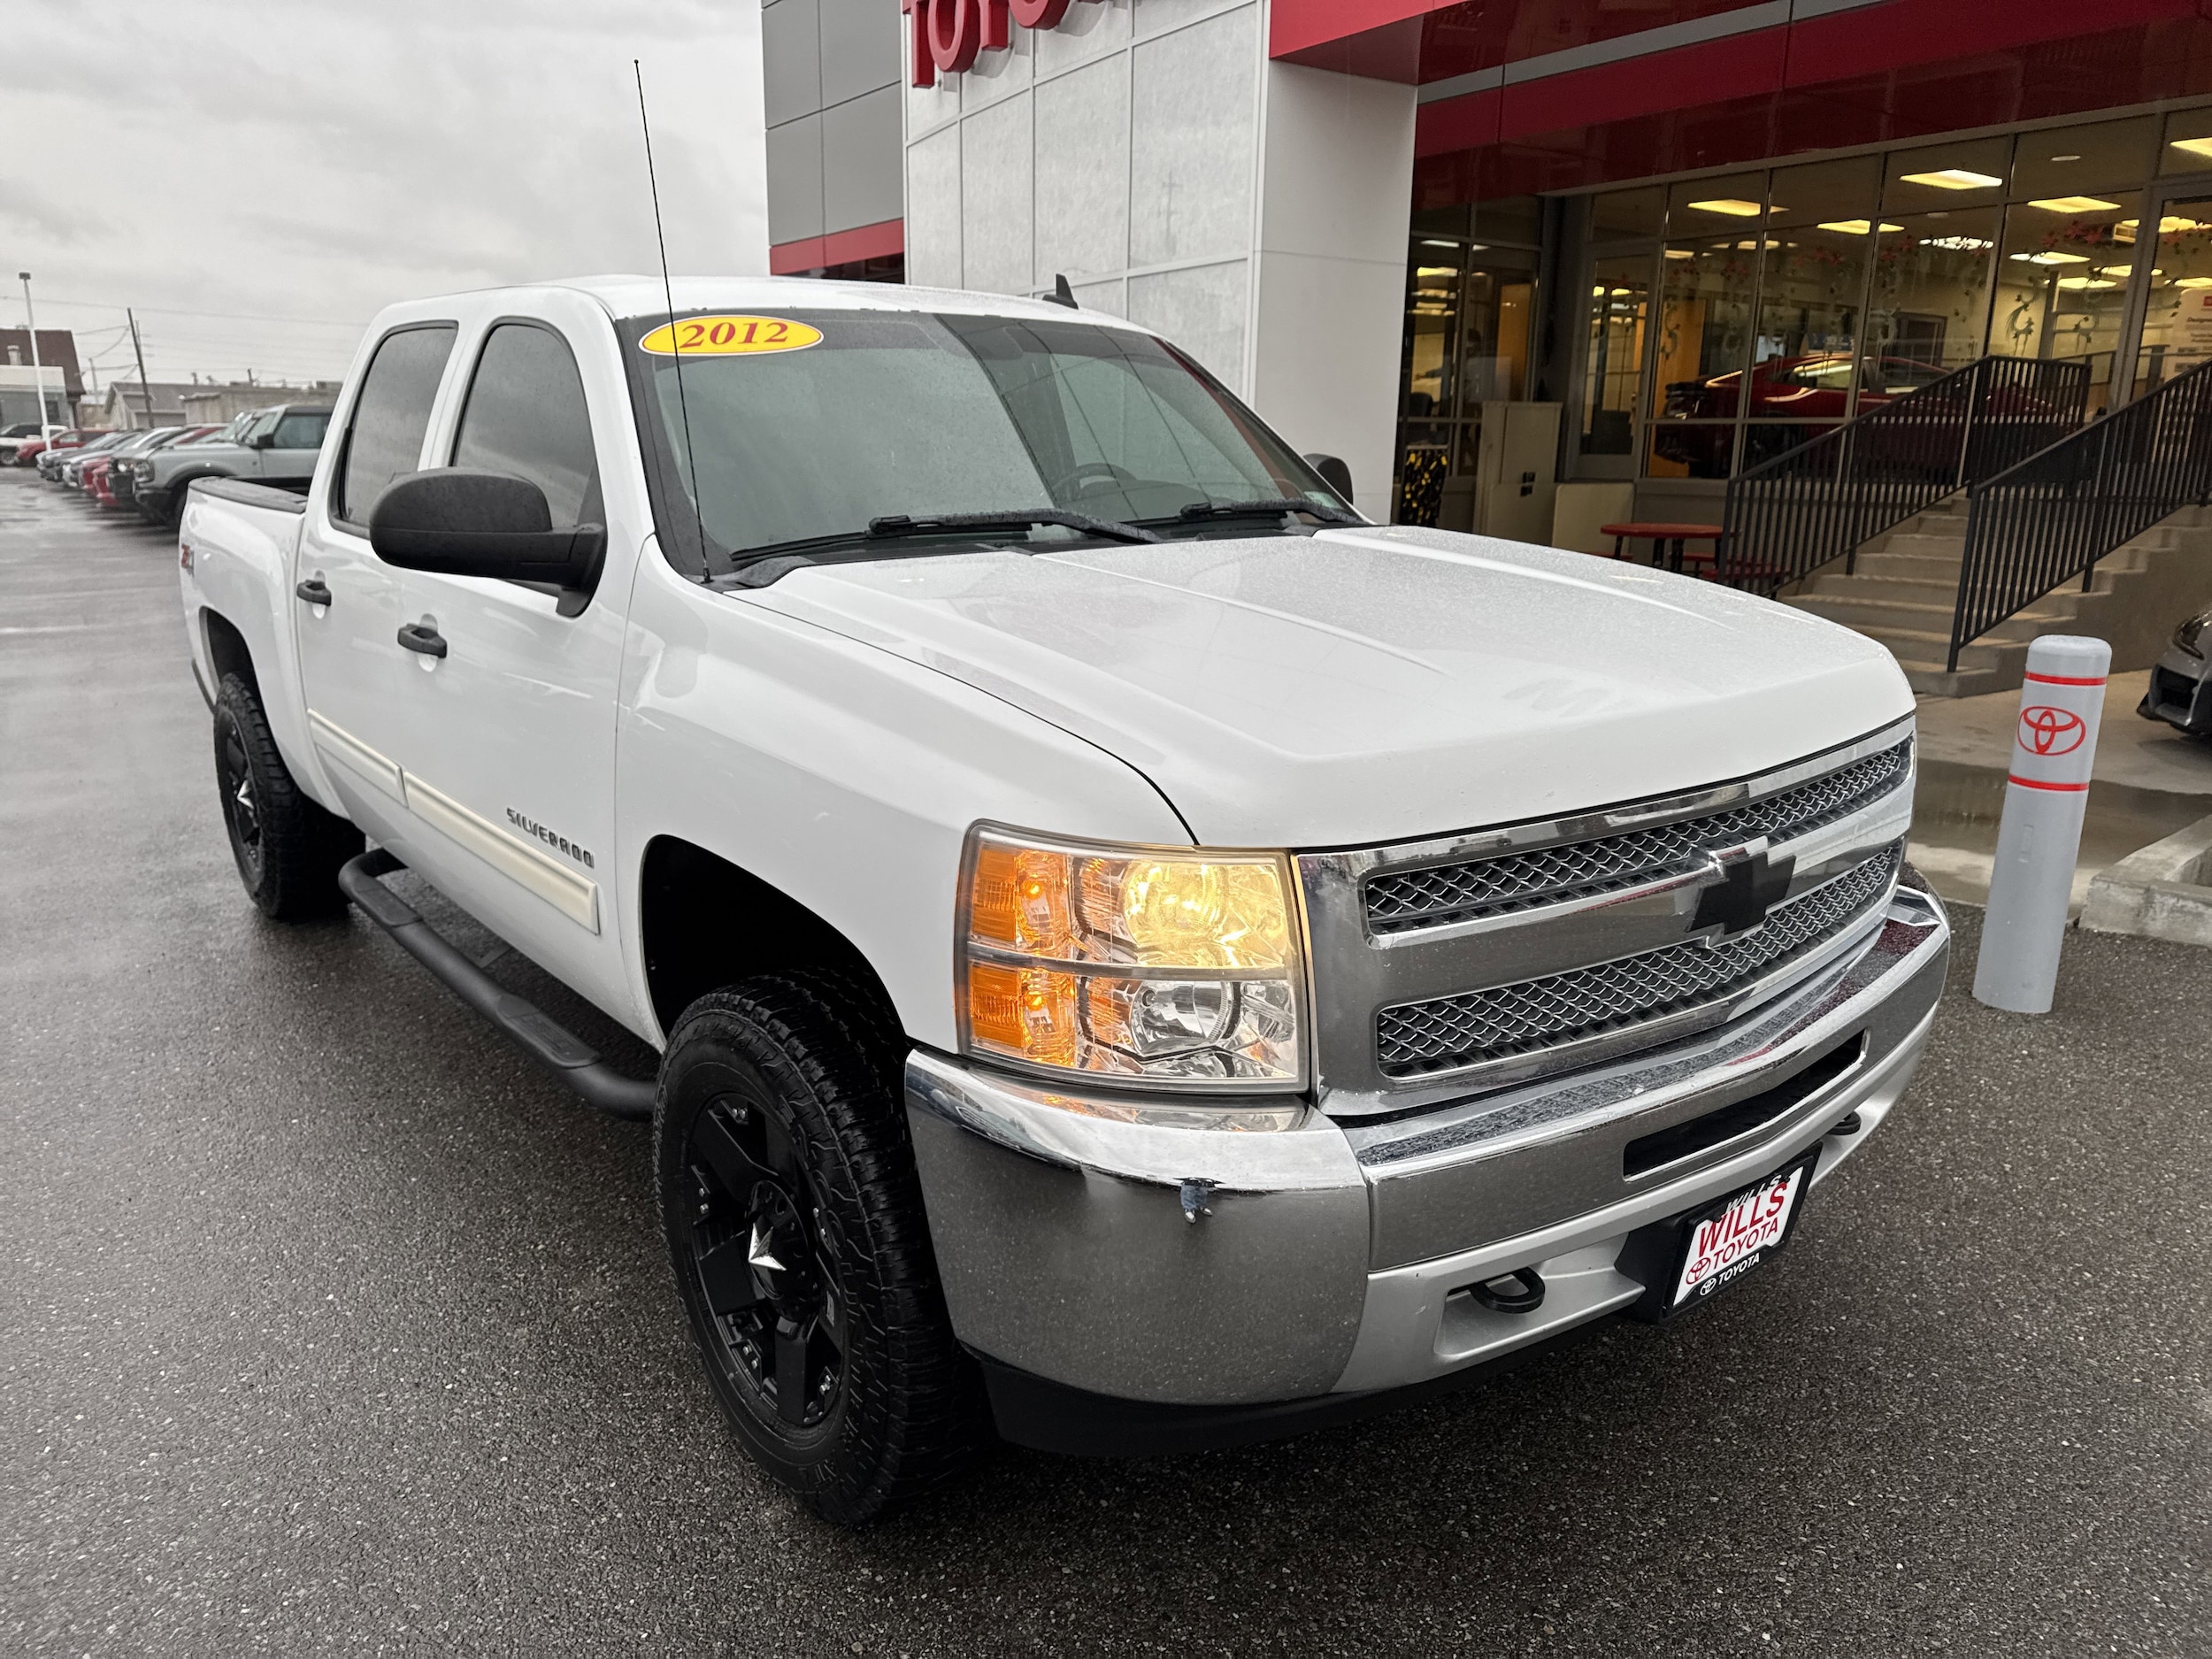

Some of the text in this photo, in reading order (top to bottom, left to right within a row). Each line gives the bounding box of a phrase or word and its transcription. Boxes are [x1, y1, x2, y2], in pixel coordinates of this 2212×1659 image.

[679, 321, 789, 349] 2012
[506, 807, 595, 869] SILVERADO
[1698, 1181, 1788, 1257] WILLS
[1714, 1217, 1778, 1270] TOYOTA
[1717, 1253, 1760, 1285] TOYOTA
